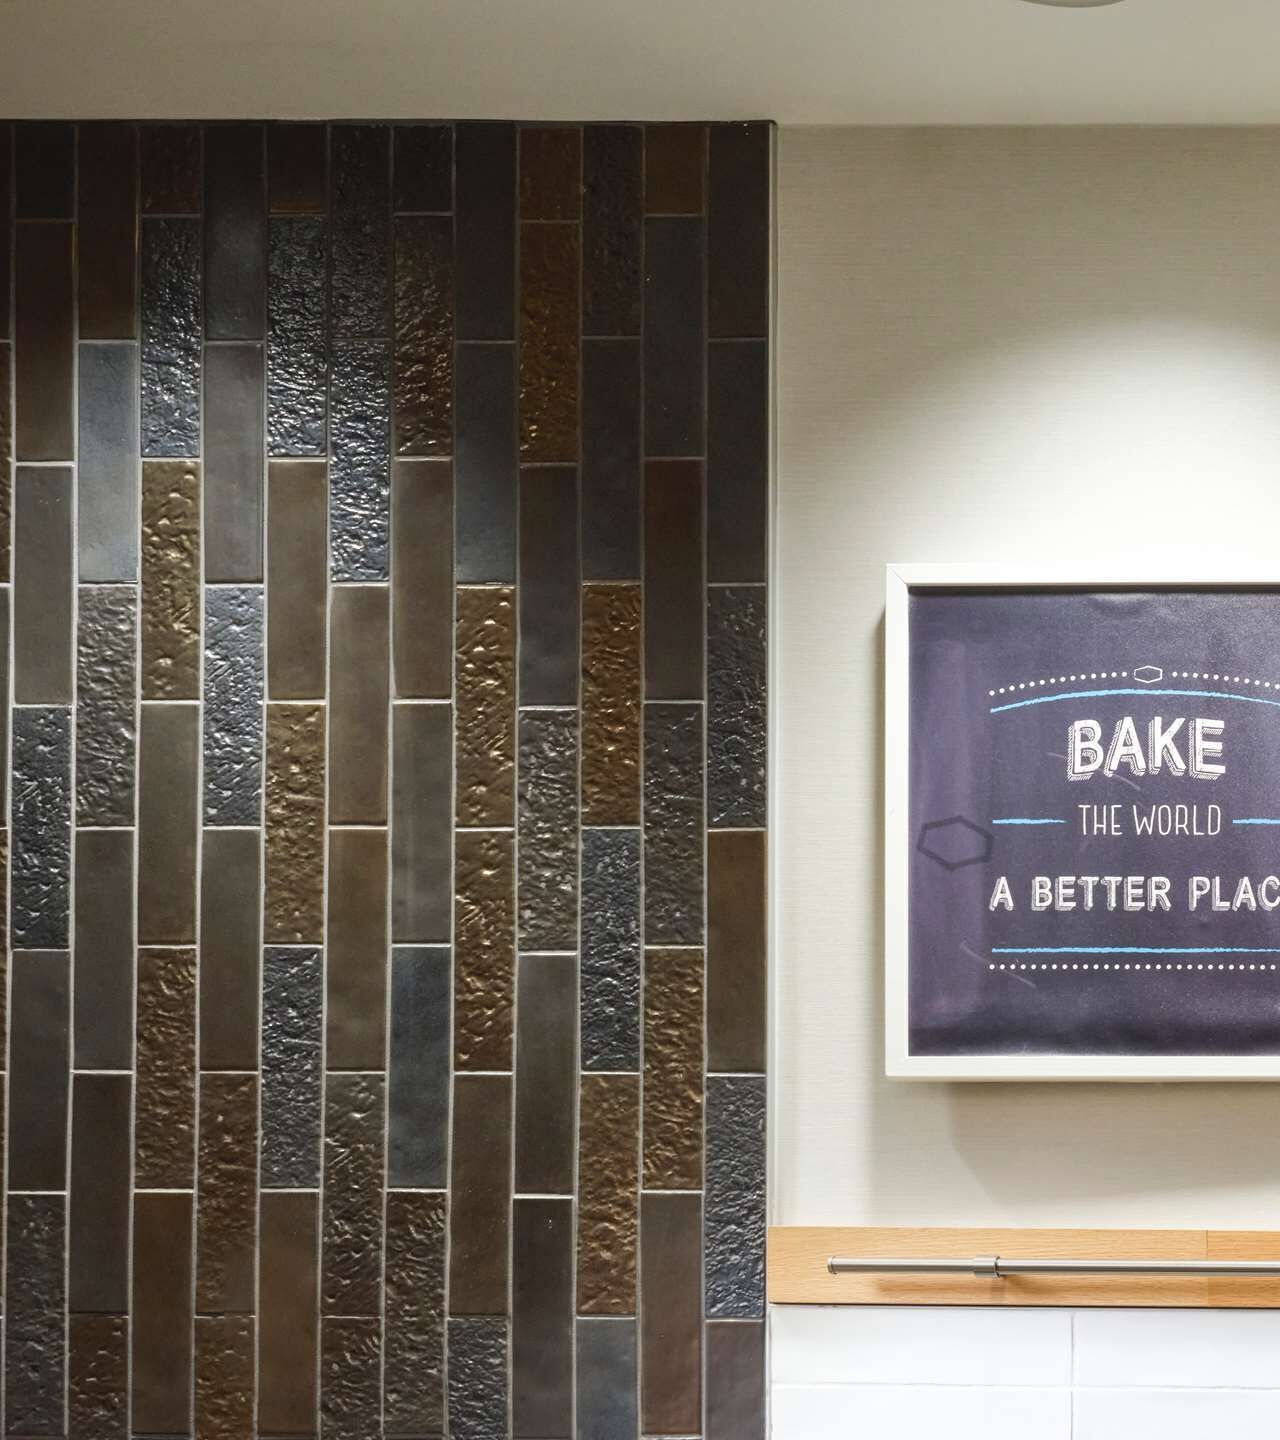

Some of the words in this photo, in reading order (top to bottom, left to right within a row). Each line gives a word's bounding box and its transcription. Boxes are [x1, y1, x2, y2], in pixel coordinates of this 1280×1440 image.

[1066, 716, 1226, 782] BAKE
[1078, 804, 1123, 837] THE
[1133, 804, 1221, 837] WORLD
[989, 875, 1014, 911] A
[1031, 875, 1172, 911] BETTER
